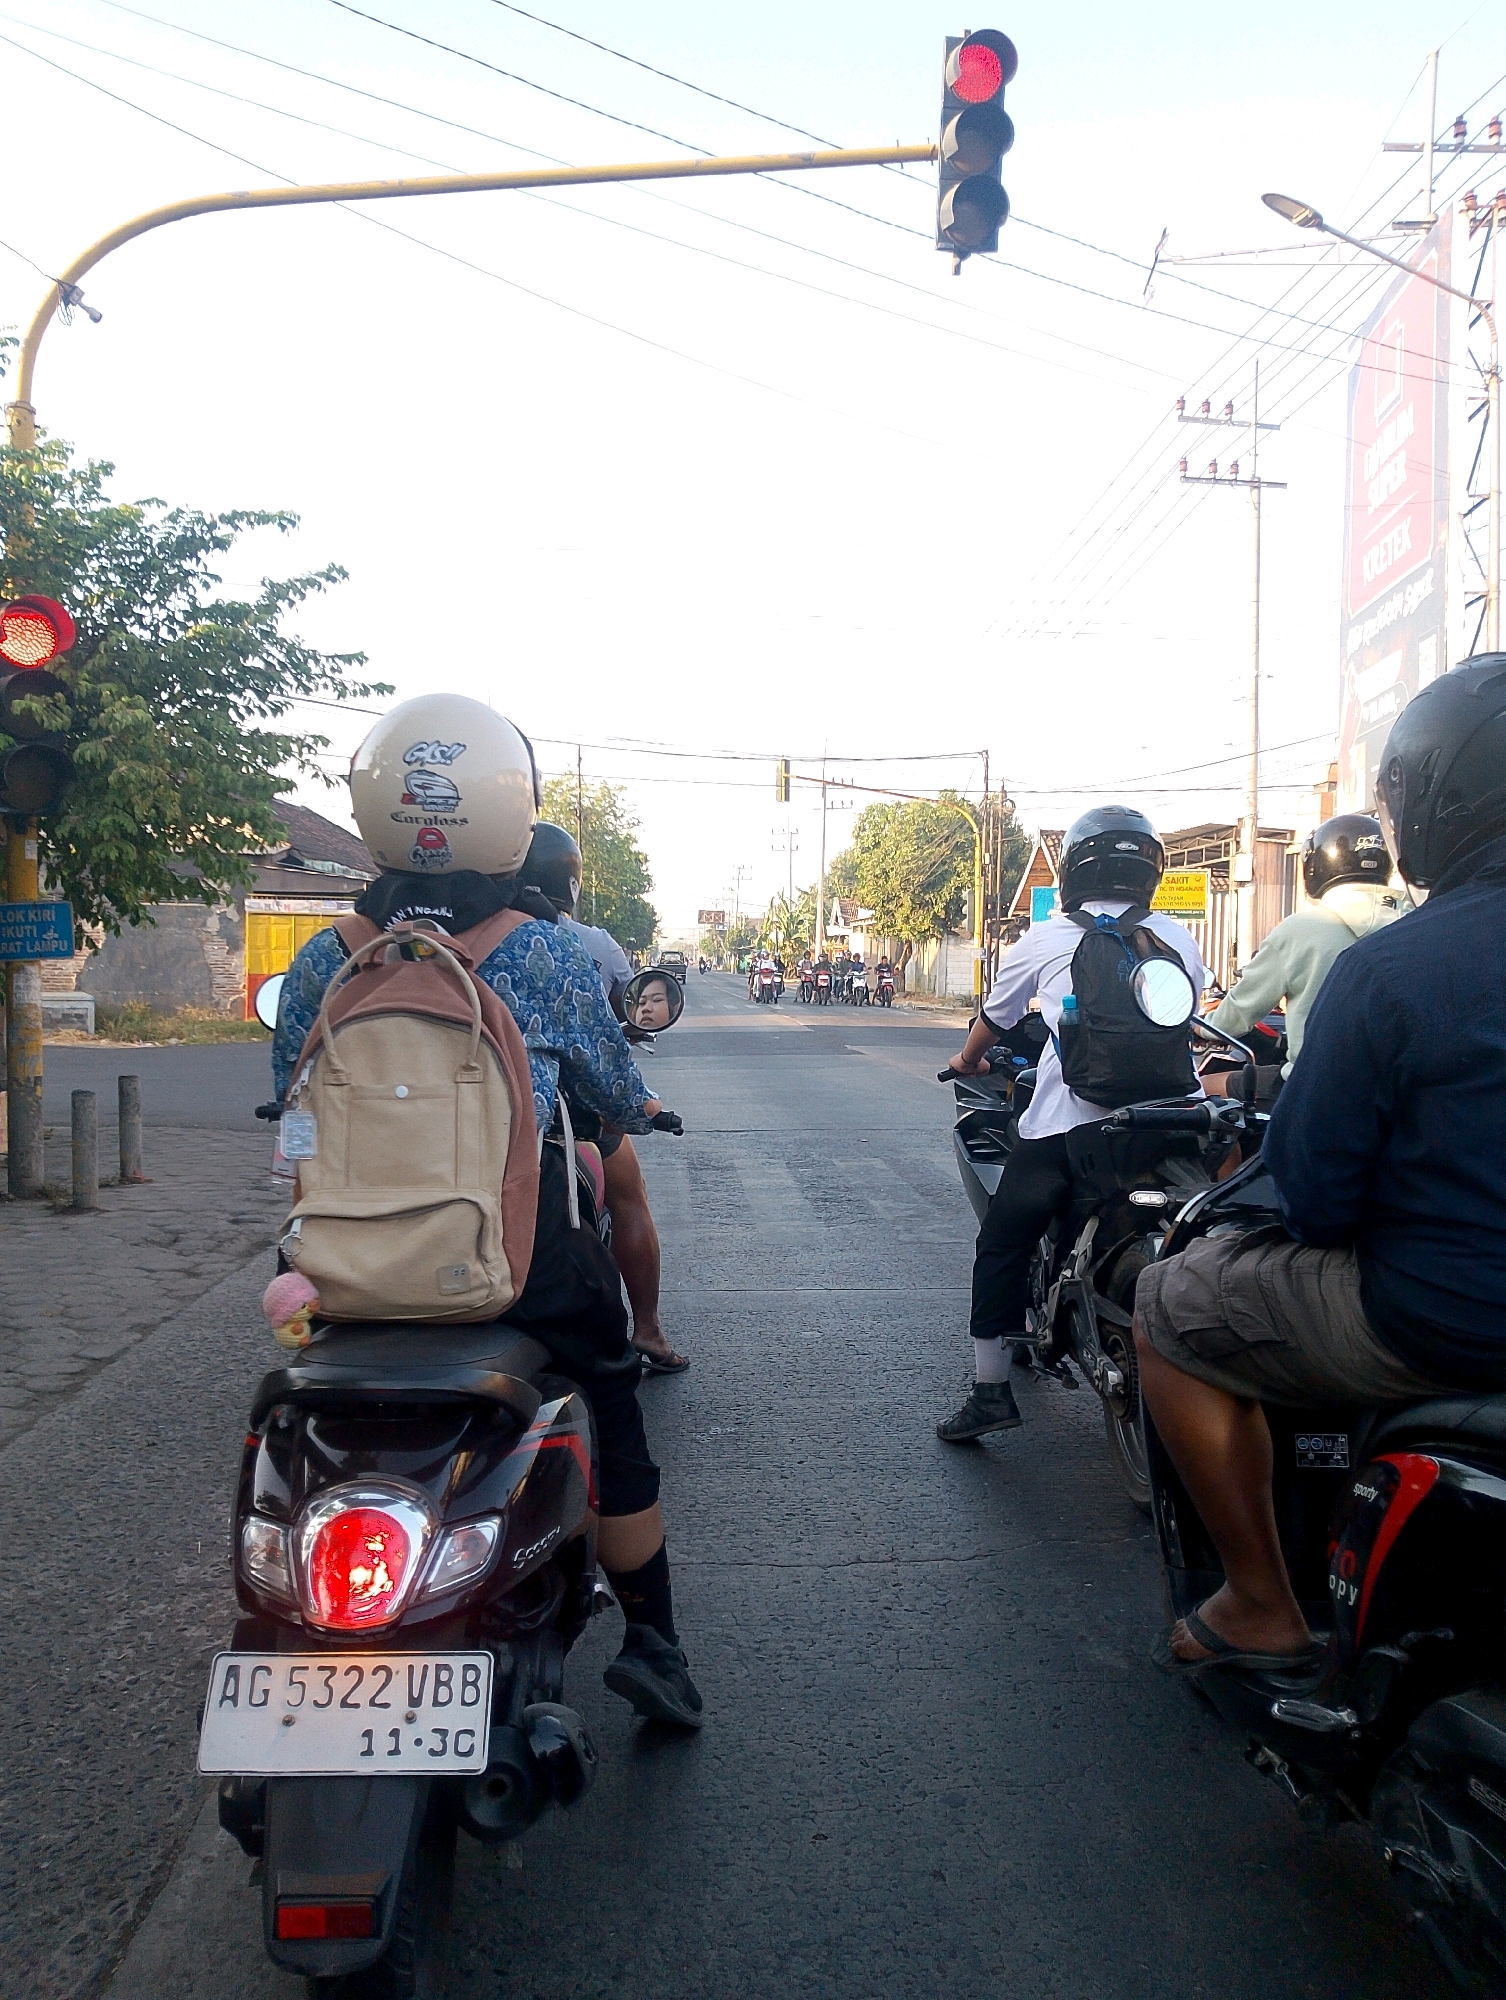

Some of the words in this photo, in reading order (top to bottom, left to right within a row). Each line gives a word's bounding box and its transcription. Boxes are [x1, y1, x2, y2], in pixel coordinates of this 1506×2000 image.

[1362, 515, 1413, 587] KRETEK
[1164, 876, 1190, 884] SAKIT
[27, 909, 56, 922] KIRI
[26, 940, 68, 953] LAMPU
[1352, 1482, 1379, 1502] sporty
[218, 1663, 273, 1708] AG
[286, 1664, 393, 1709] 5322
[406, 1663, 482, 1708] VBB
